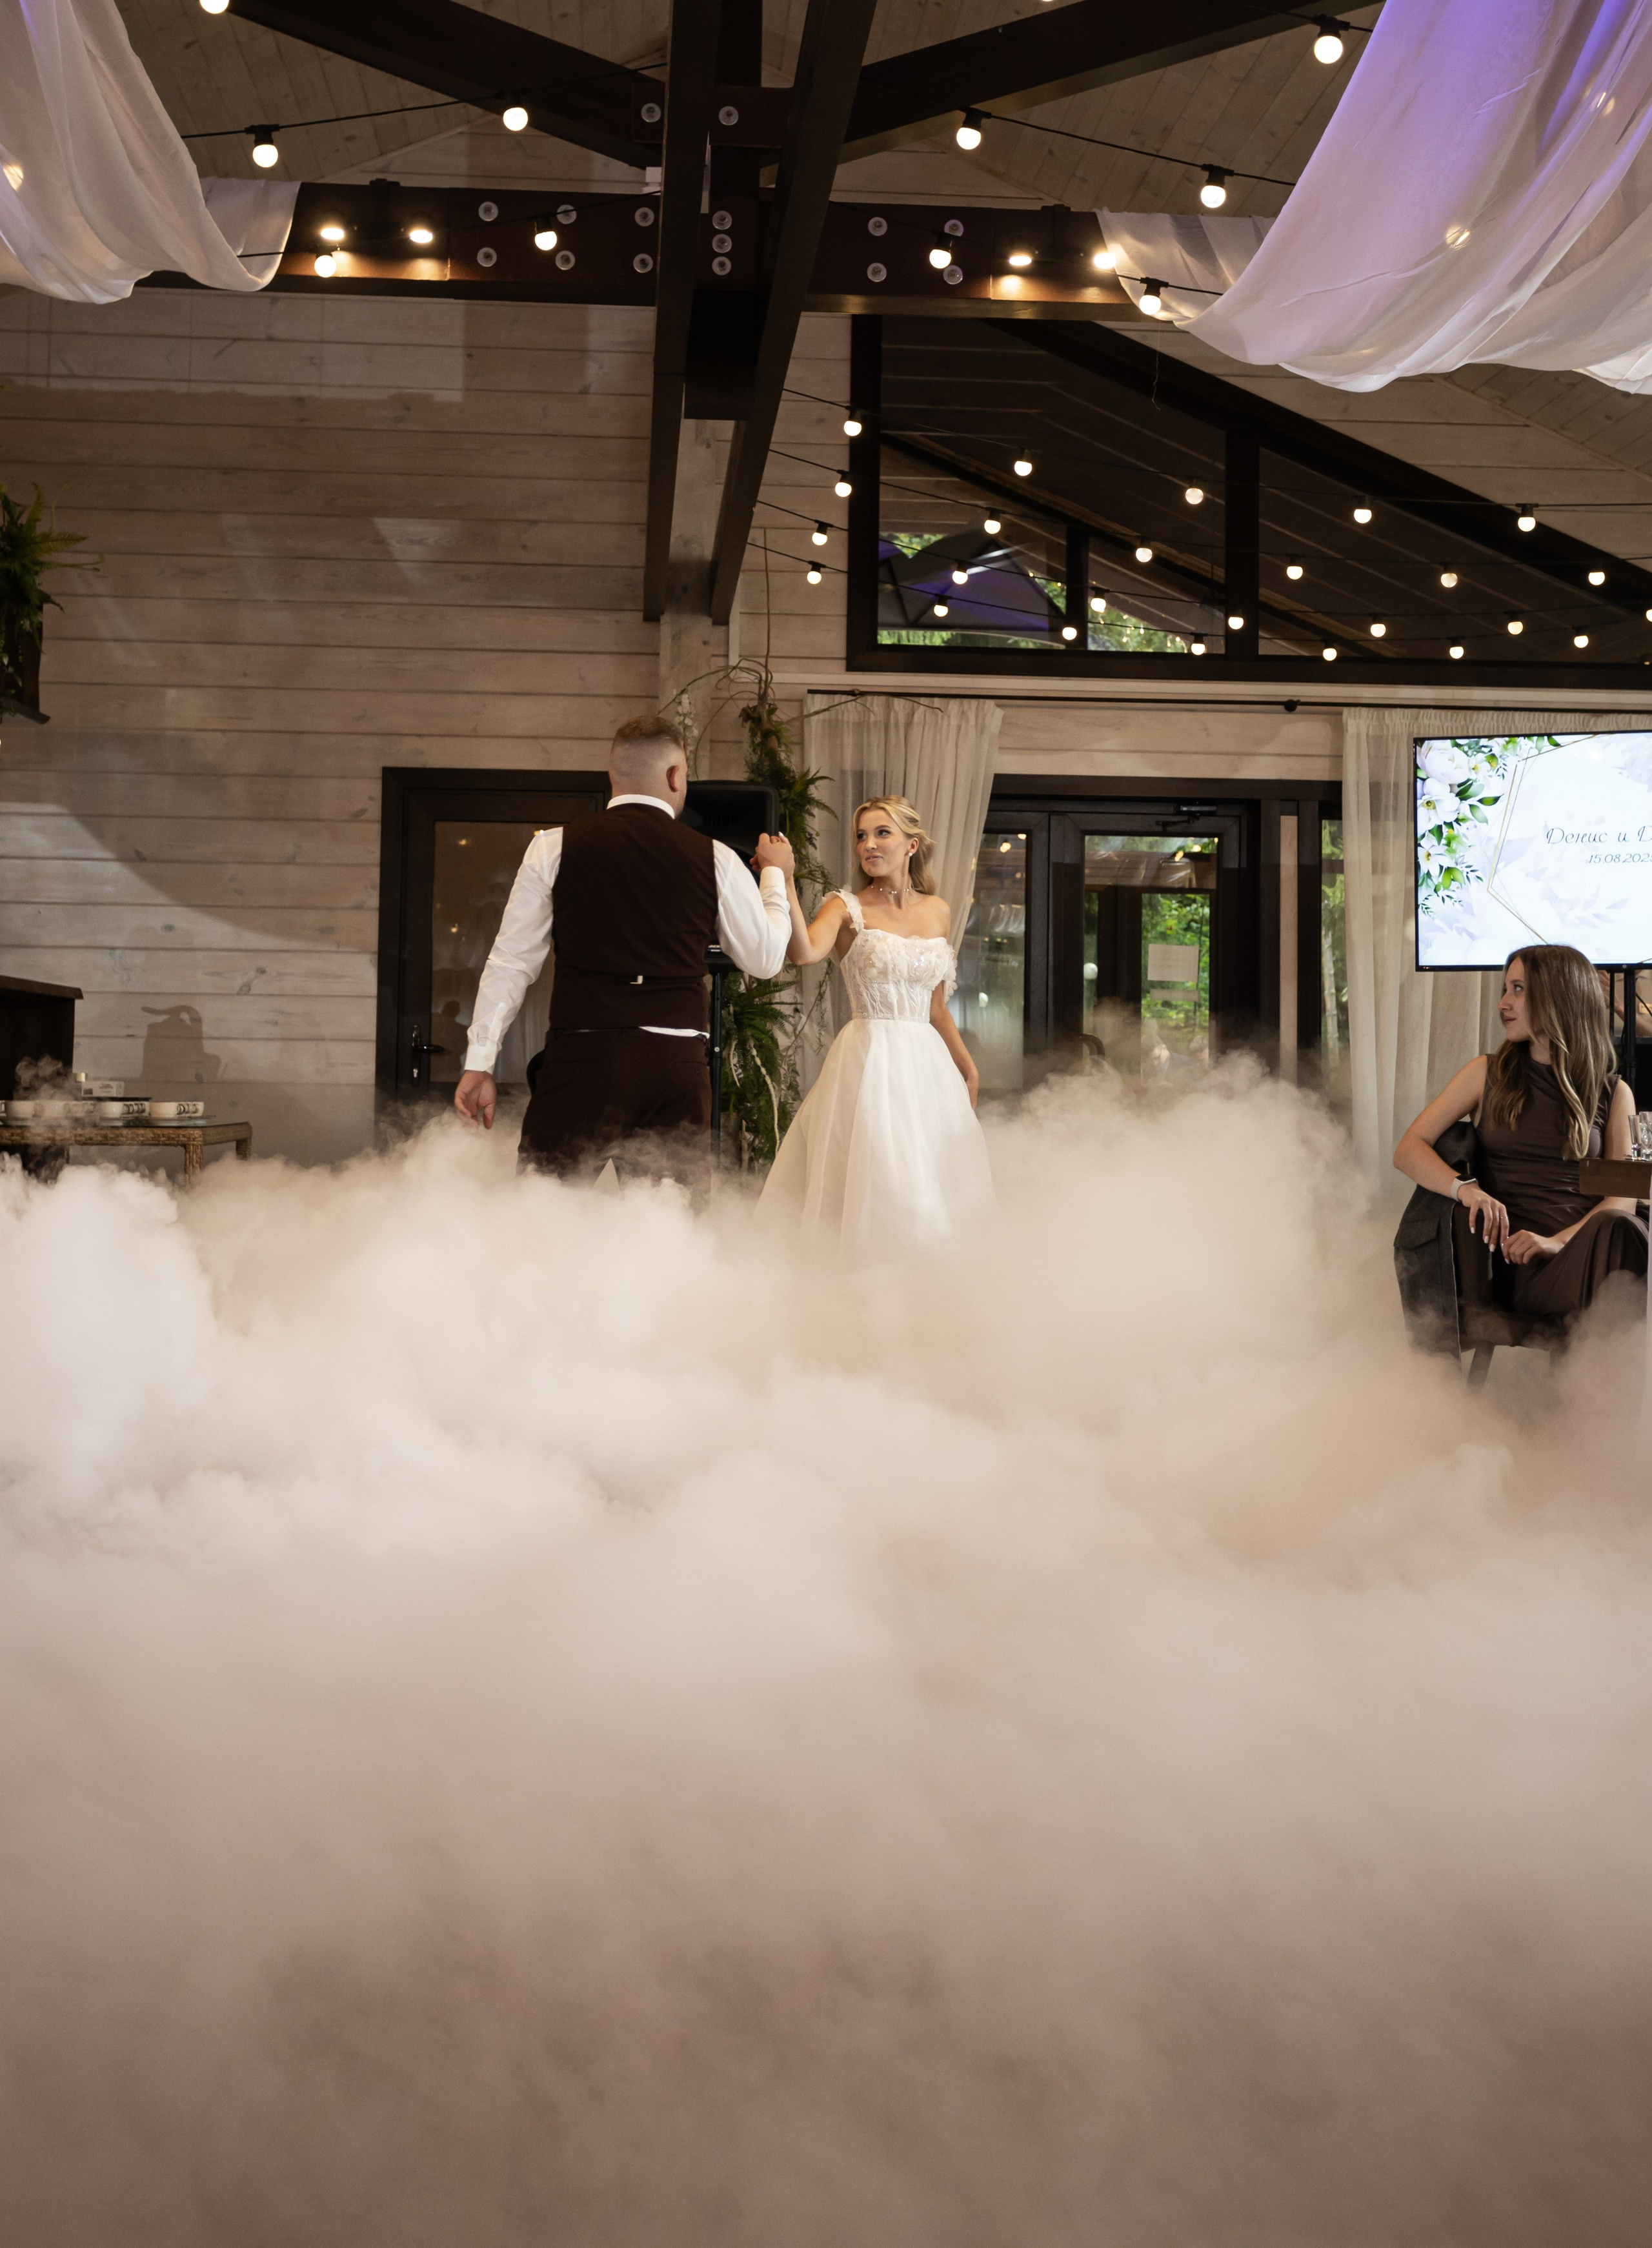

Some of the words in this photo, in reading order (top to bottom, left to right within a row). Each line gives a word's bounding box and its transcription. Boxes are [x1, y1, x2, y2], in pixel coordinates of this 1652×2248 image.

[1546, 827, 1607, 844] Денис
[1618, 832, 1630, 843] и
[1589, 852, 1652, 863] 15.08.202
